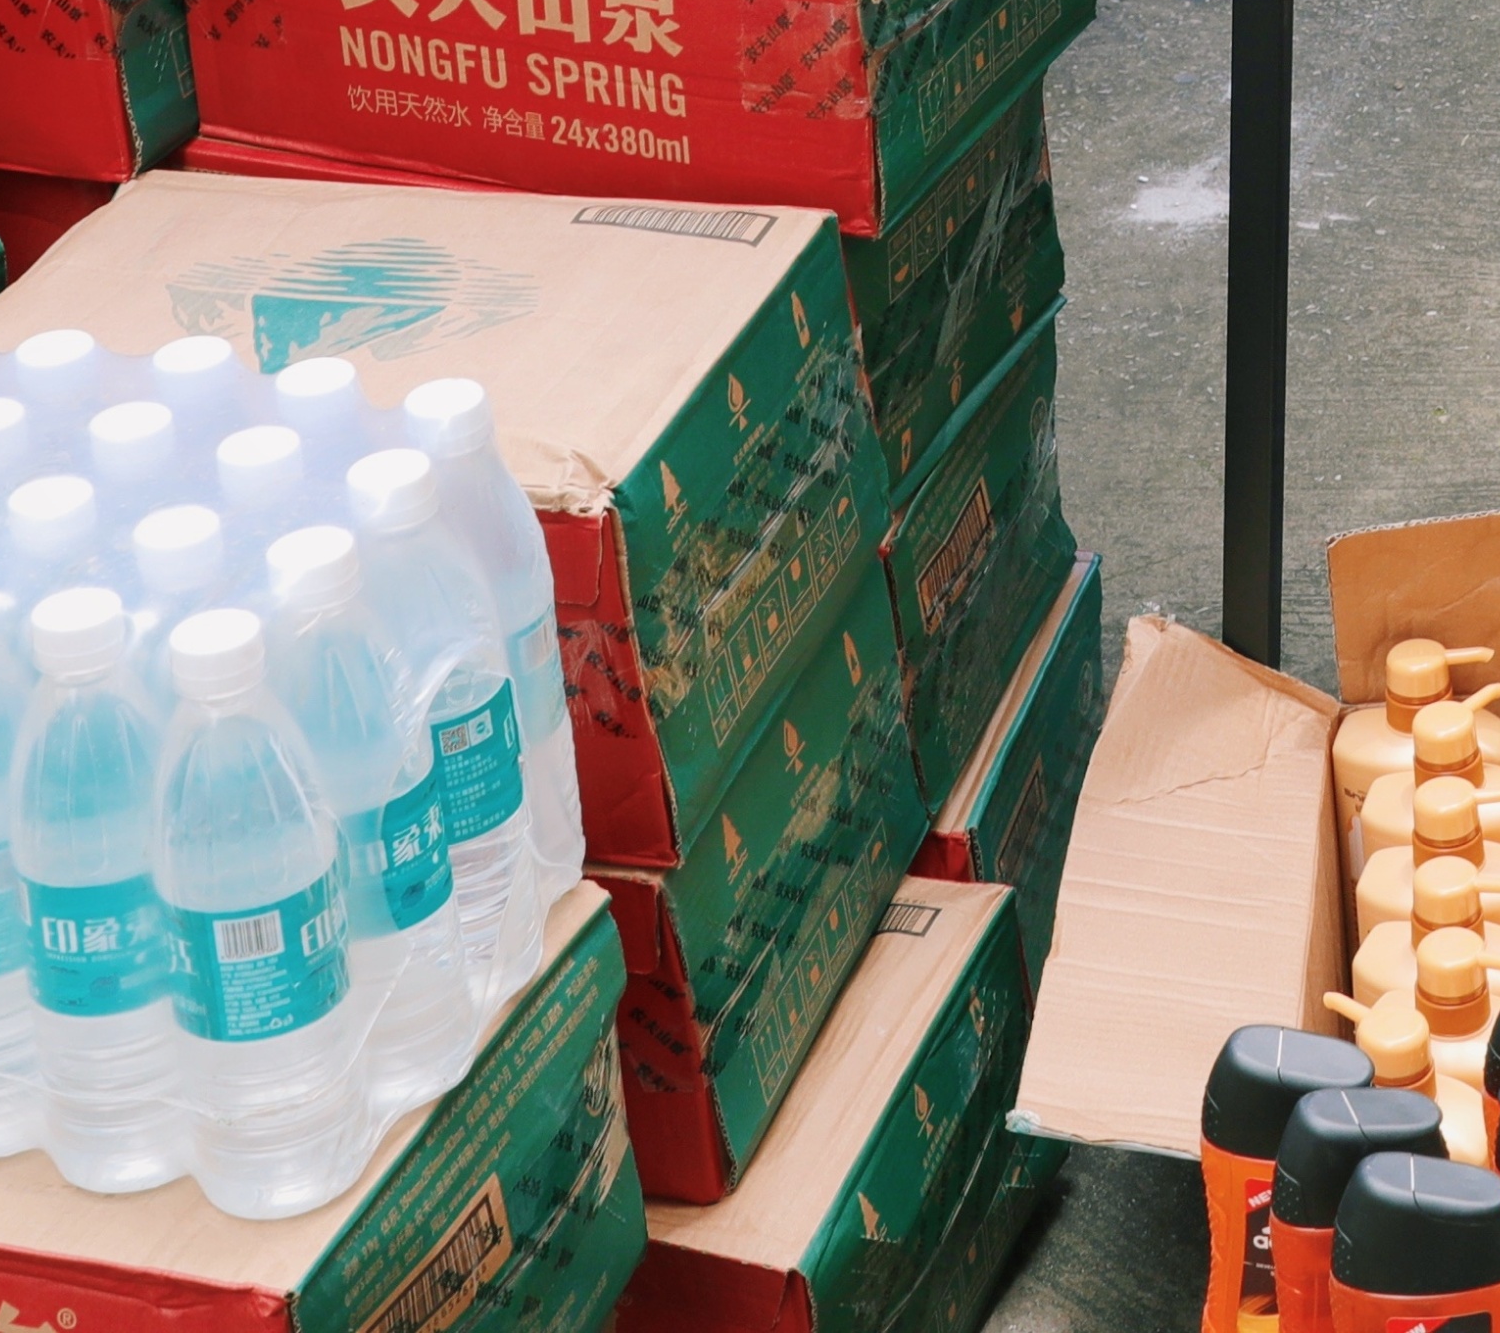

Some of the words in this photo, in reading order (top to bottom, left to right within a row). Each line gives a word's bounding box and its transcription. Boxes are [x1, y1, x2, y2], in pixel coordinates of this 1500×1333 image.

[341, 26, 509, 91] NONGFU
[527, 54, 689, 120] SPRING
[347, 83, 472, 129] 饮用天然水
[482, 104, 546, 144] 净含量
[550, 114, 692, 167] 24x380ml
